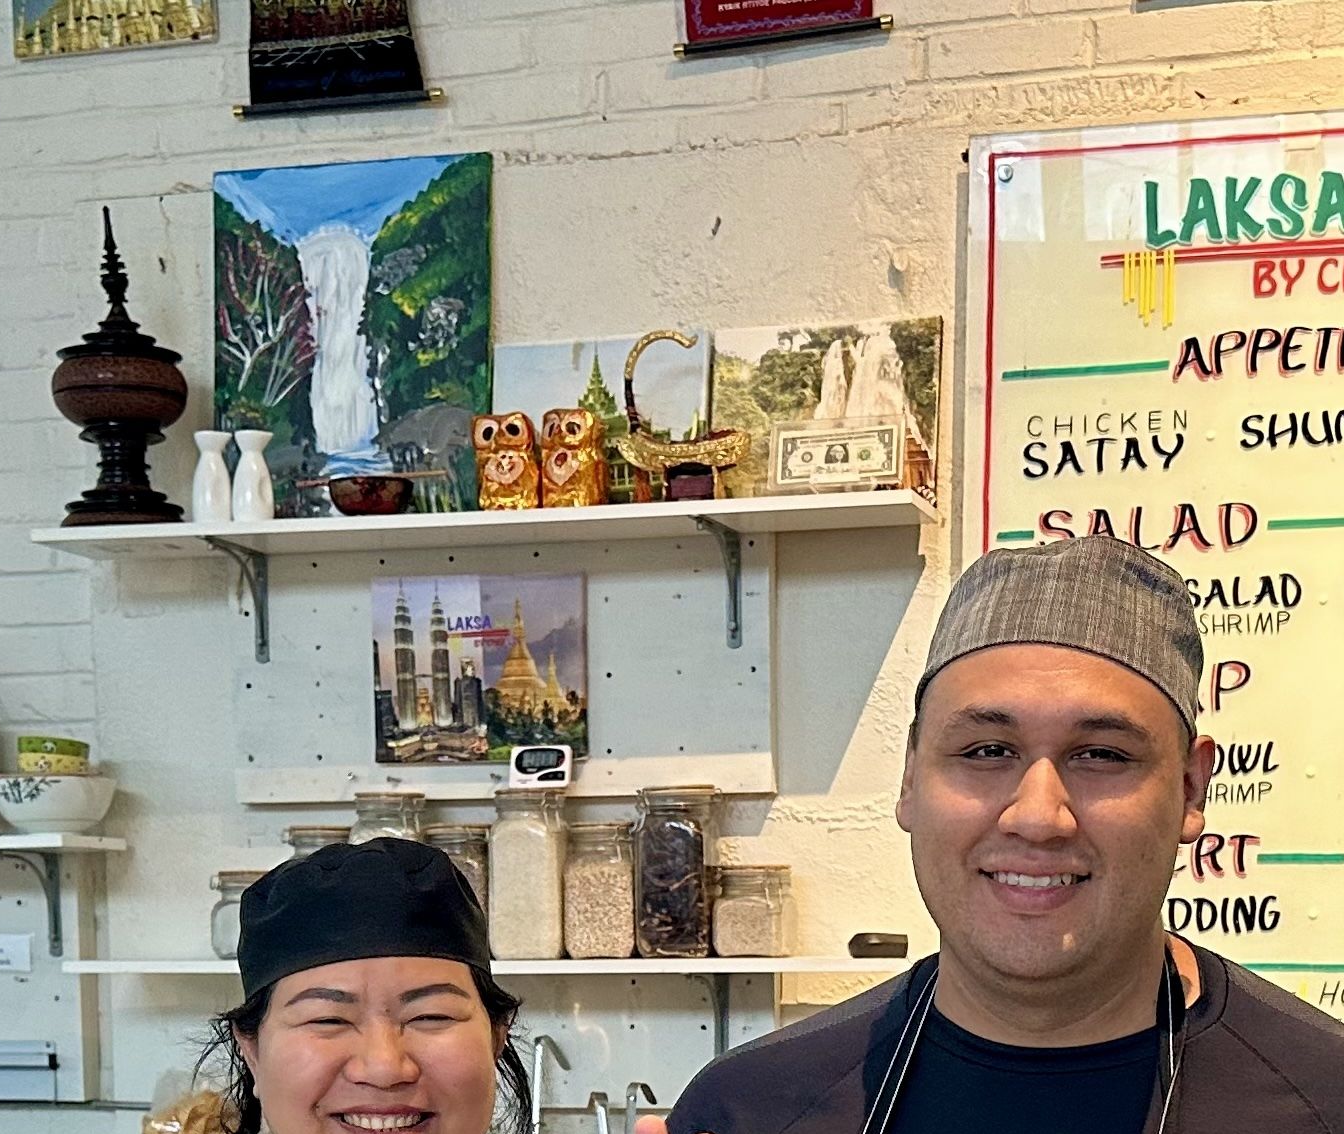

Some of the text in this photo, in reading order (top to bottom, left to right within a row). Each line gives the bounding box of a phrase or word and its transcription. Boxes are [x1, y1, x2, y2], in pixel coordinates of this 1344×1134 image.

[1254, 256, 1306, 298] BY
[1027, 409, 1190, 439] CHICKEN
[1022, 434, 1186, 480] SATAY
[1037, 502, 1259, 551] SALAD
[1185, 573, 1302, 609] SALAD
[447, 615, 491, 631] LAKSA
[1198, 611, 1291, 636] SHRIMP
